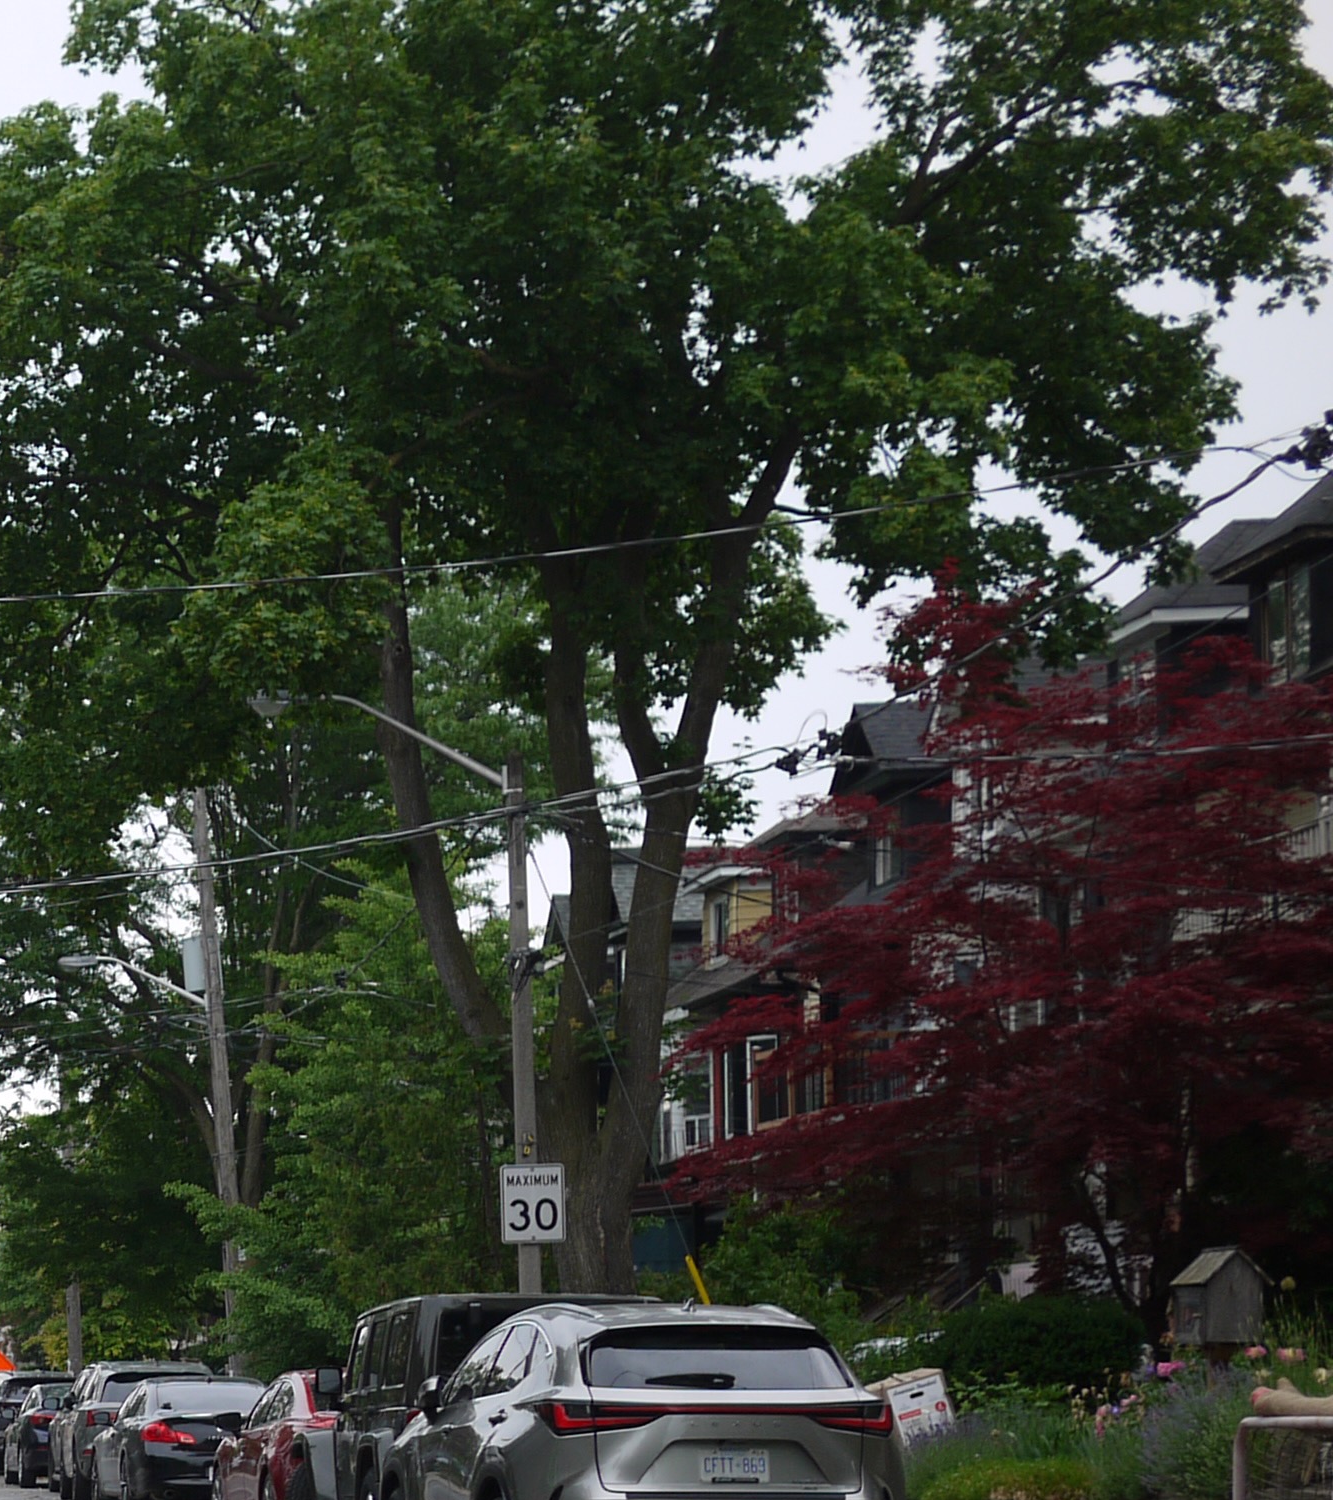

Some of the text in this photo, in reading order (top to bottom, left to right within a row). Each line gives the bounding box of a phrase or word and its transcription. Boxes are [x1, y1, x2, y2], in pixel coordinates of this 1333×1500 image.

[506, 1174, 559, 1187] MAXIMUM
[509, 1198, 558, 1232] 30
[742, 1457, 766, 1473] 869
